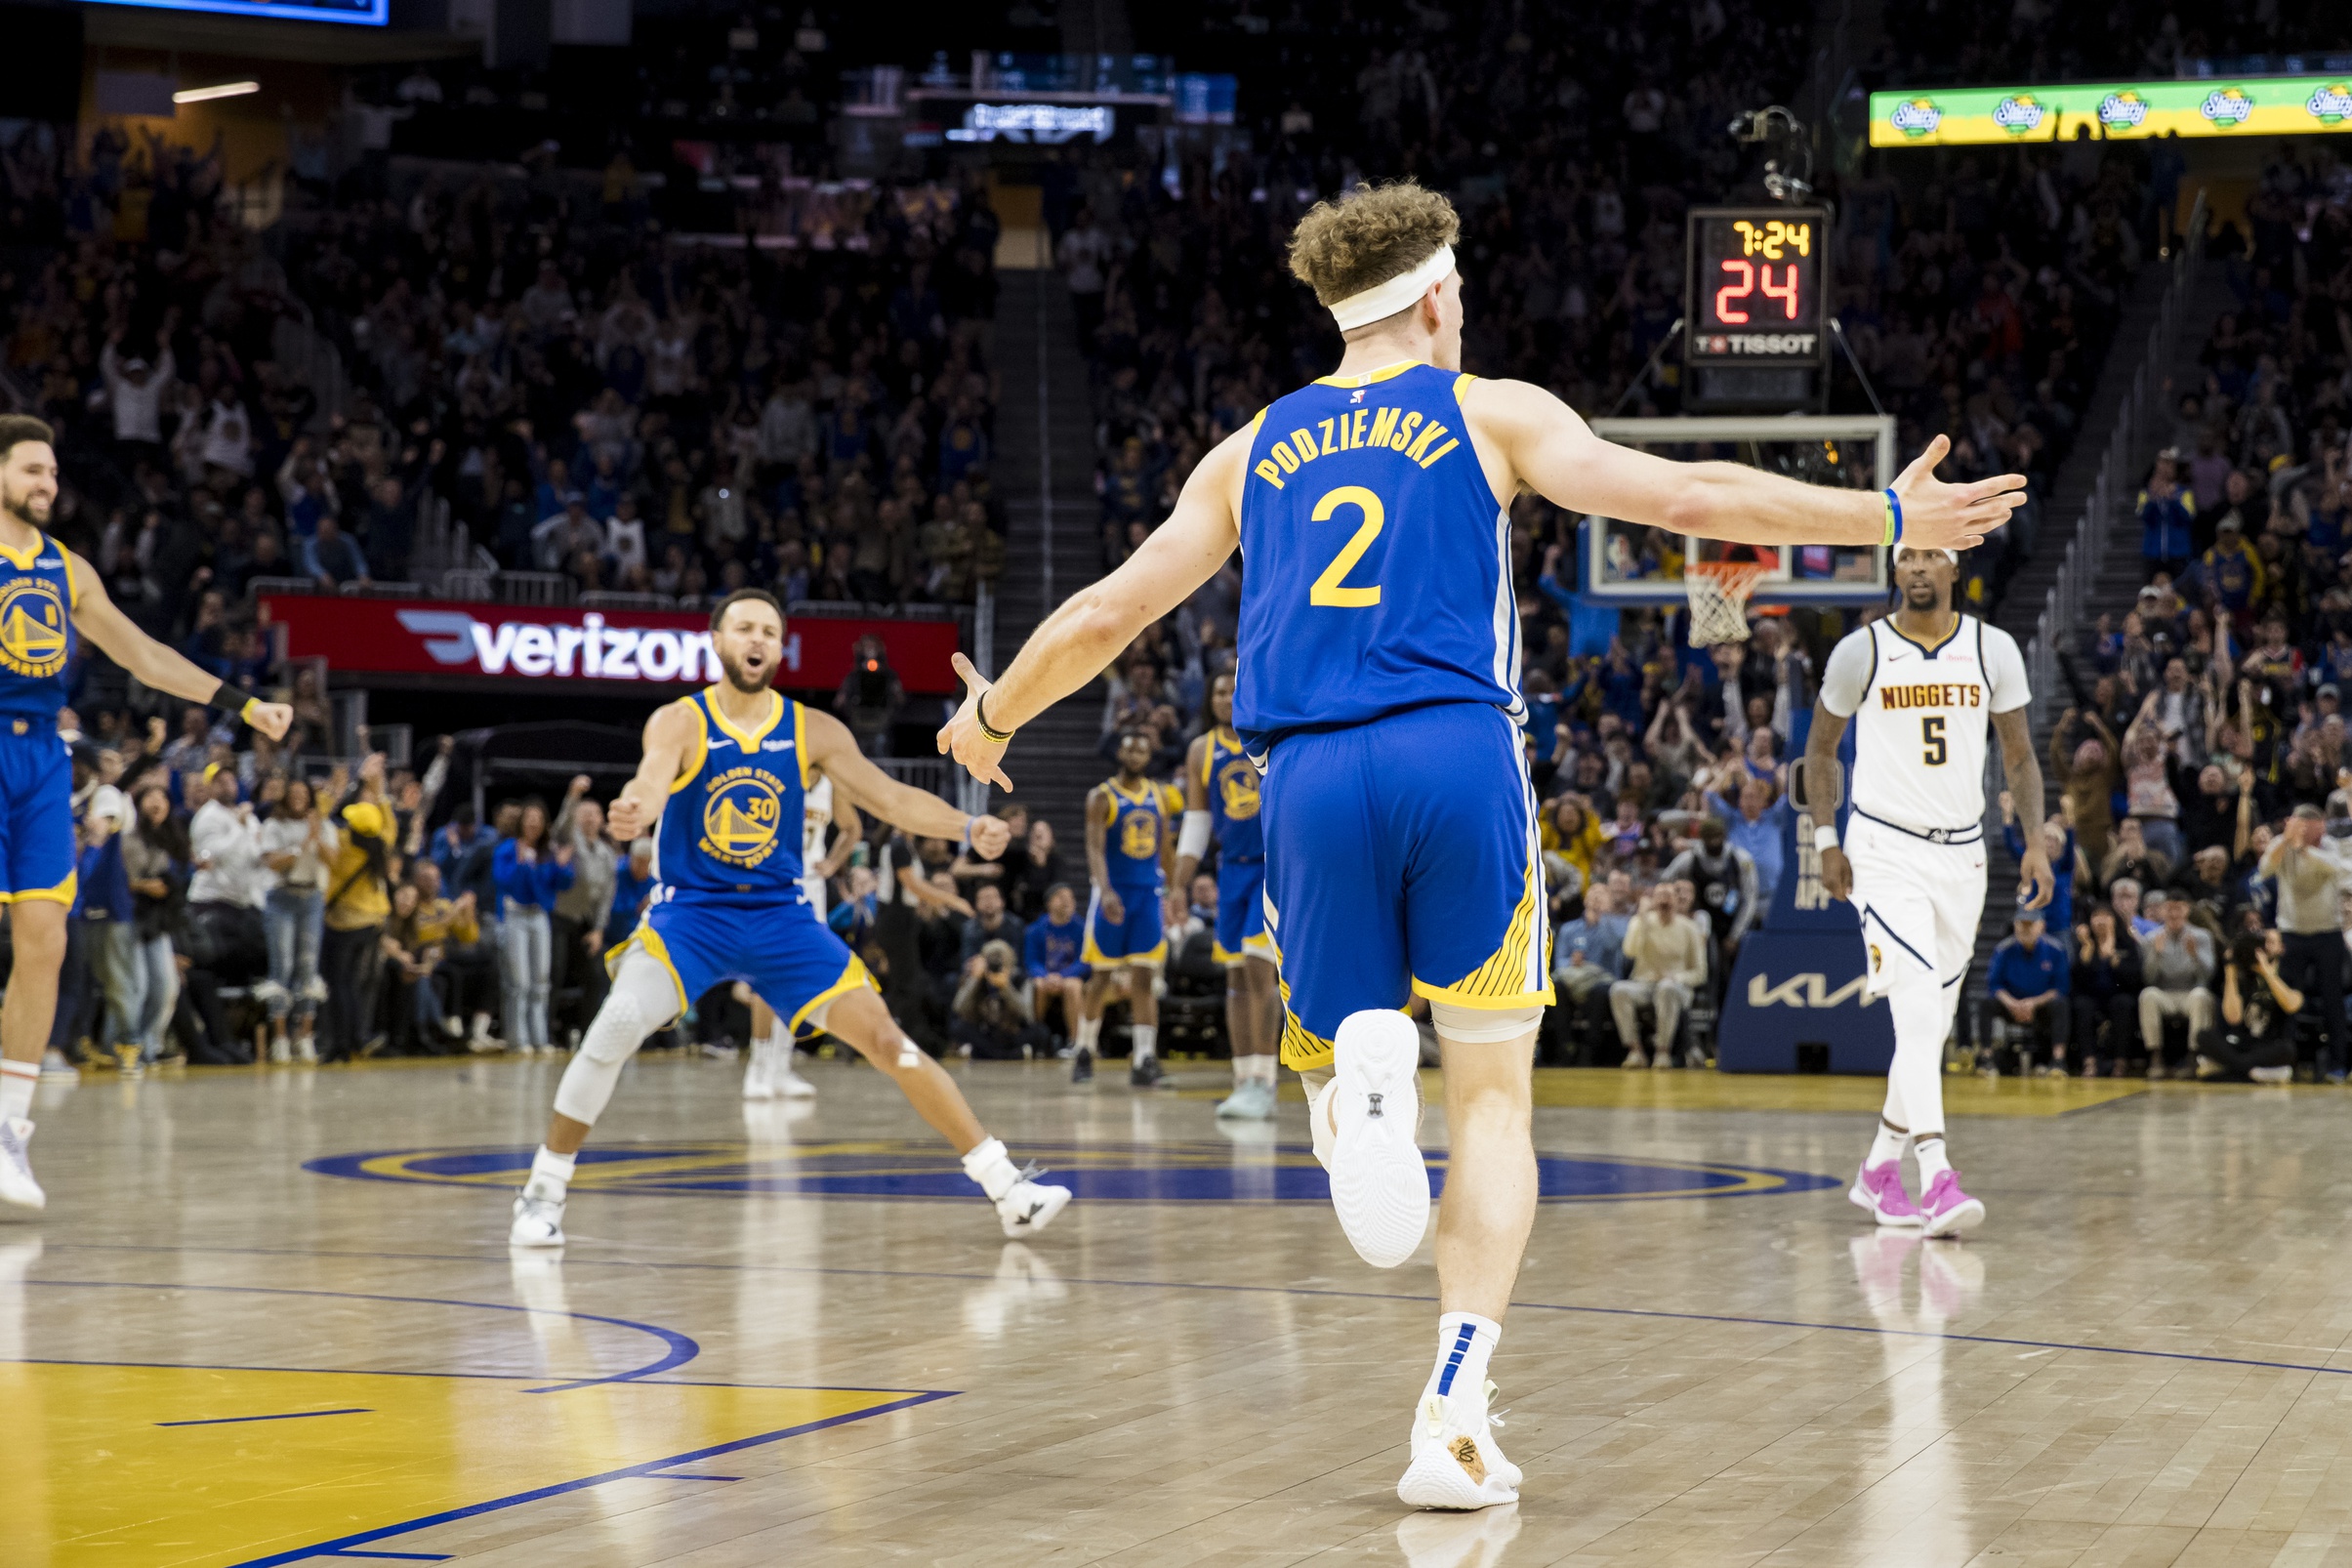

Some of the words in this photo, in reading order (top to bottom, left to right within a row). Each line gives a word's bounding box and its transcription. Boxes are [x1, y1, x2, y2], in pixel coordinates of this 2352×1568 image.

[1733, 221, 1810, 260] 7:24
[1715, 260, 1798, 324] 24
[1728, 334, 1817, 354] TISSOT
[1254, 407, 1461, 490] PODZIEMSKI
[1310, 485, 1385, 608] 2
[471, 612, 723, 682] verizon
[1880, 684, 1981, 710] NUGGETS
[1921, 715, 1948, 766] 5
[705, 766, 753, 793] GOLDEN
[755, 767, 787, 795] STATE
[745, 798, 775, 821] 30
